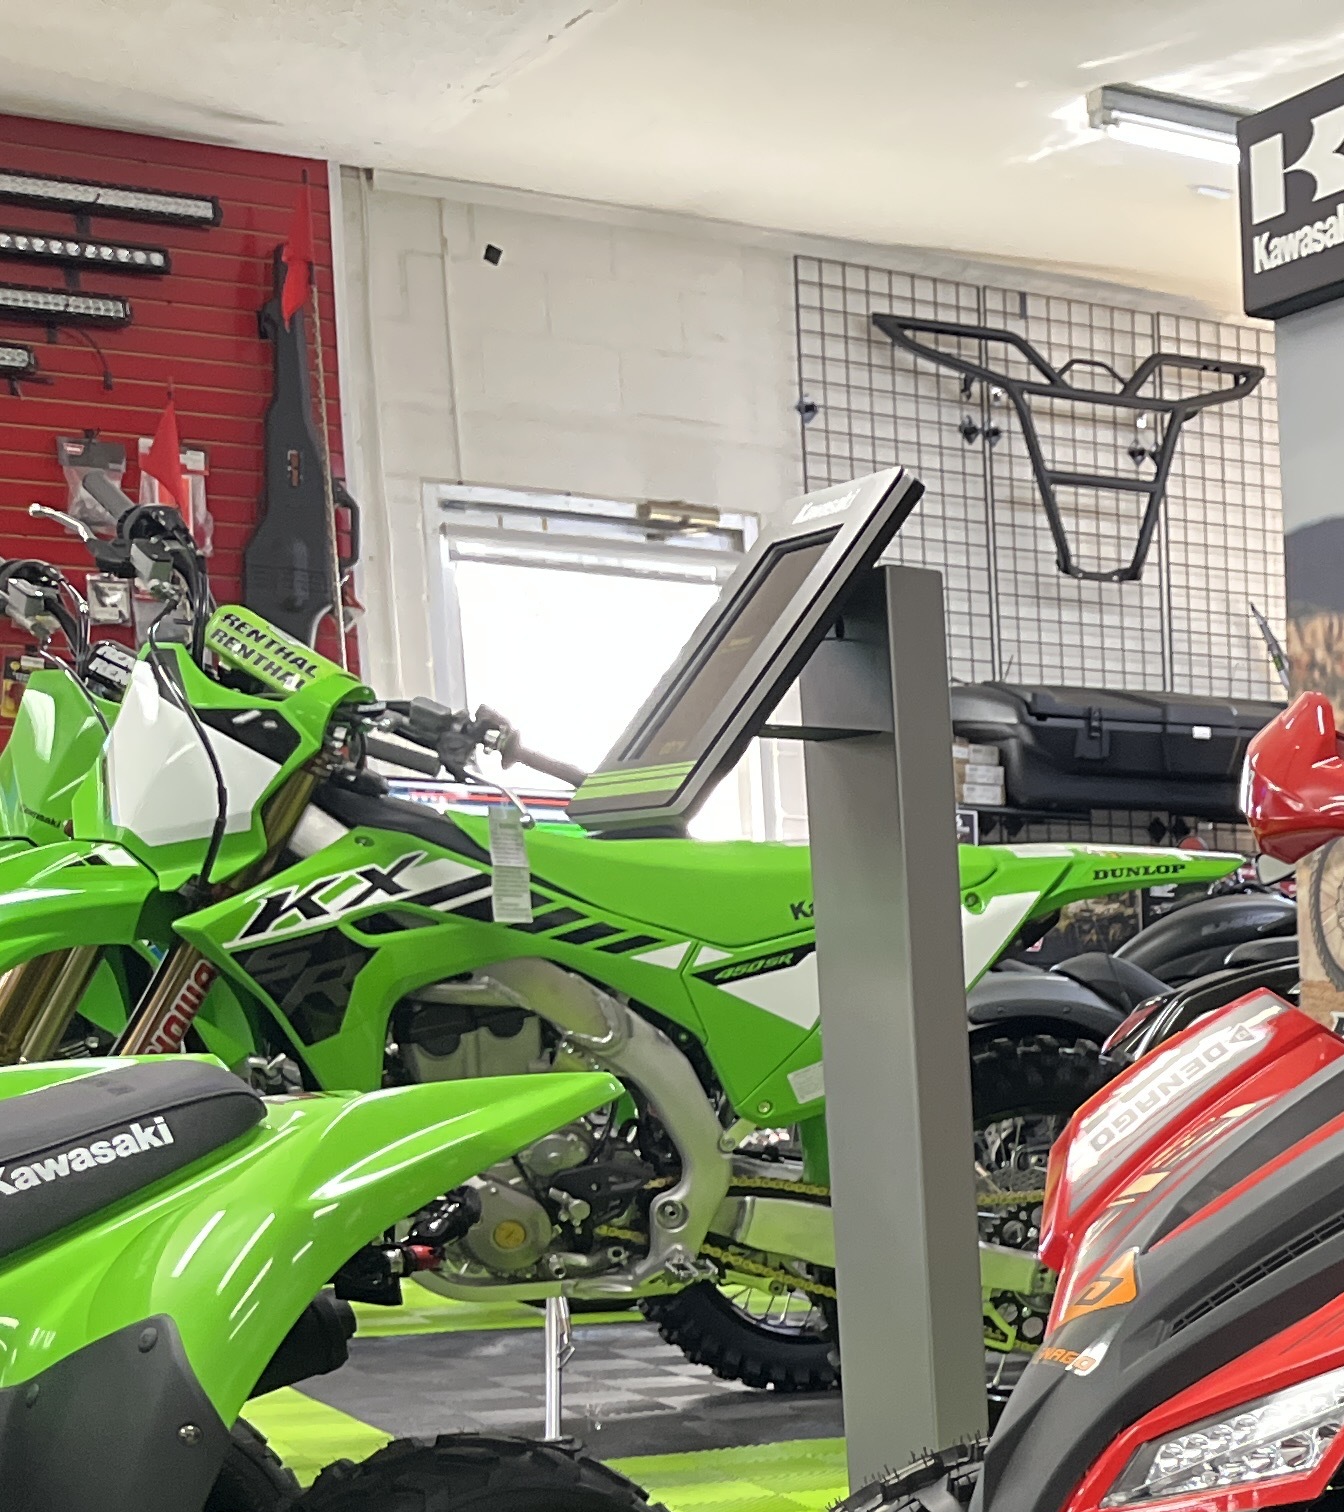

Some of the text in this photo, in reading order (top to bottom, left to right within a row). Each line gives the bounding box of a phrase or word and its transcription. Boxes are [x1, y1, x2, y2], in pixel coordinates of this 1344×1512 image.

[220, 612, 322, 680] RENTHAL
[236, 850, 428, 942] KX
[1093, 863, 1187, 881] DUNLOP
[1090, 1040, 1231, 1153] DENAGO
